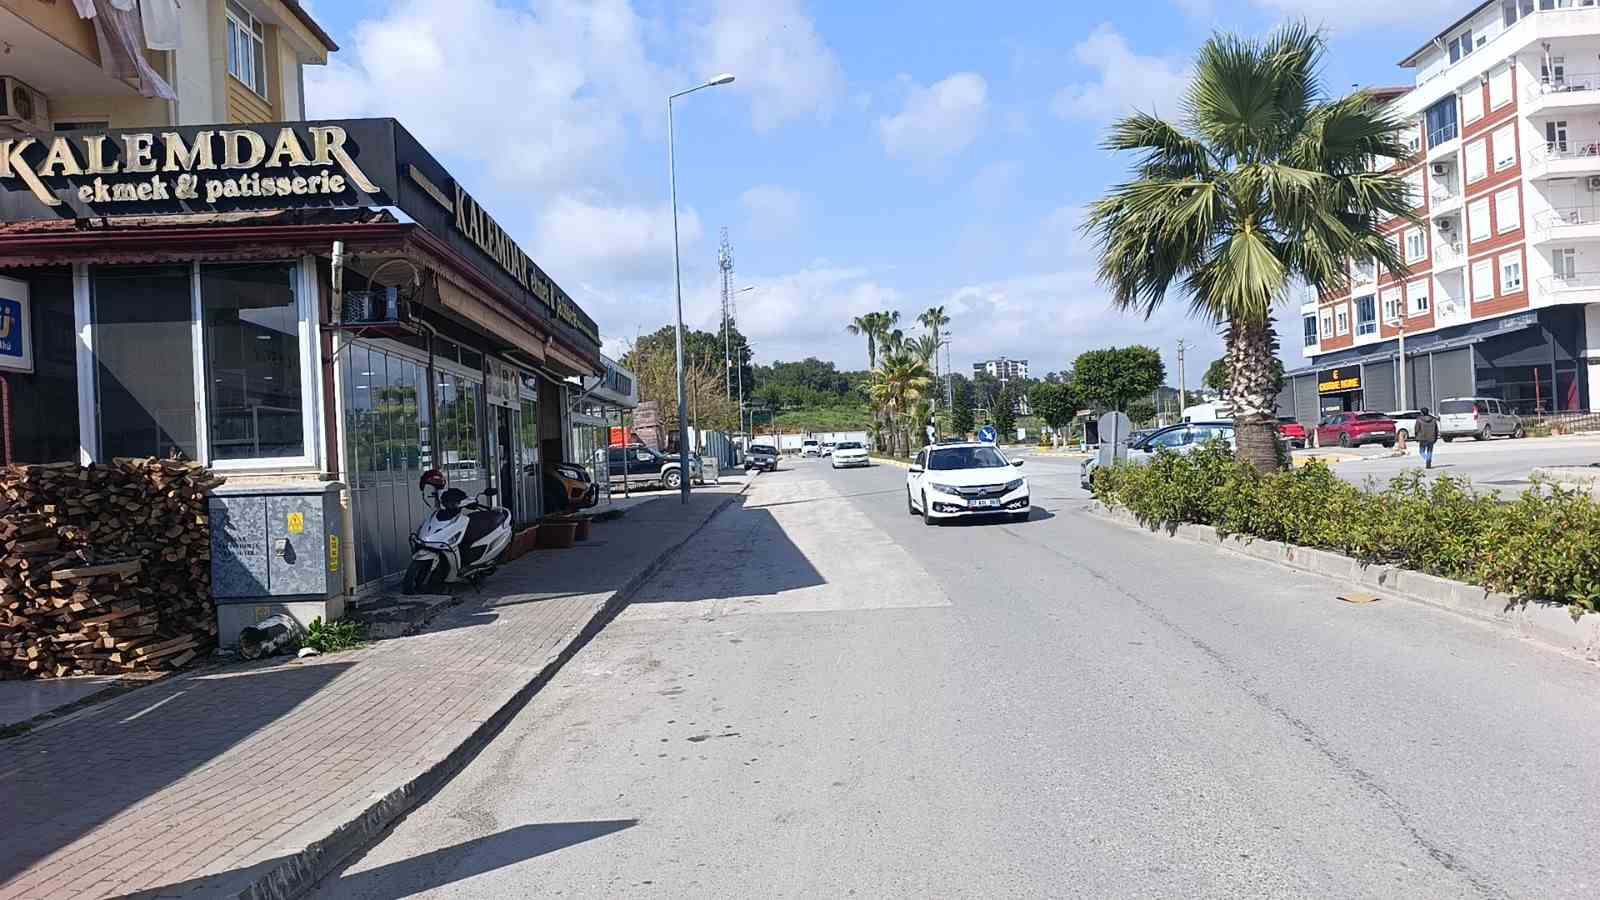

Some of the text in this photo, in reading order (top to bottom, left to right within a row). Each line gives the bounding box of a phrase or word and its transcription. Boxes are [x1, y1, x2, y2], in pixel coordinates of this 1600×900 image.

[0, 126, 380, 206] KALEMDAR
[78, 170, 345, 203] ekmek & patisserie
[455, 186, 529, 290] KALEMDAR
